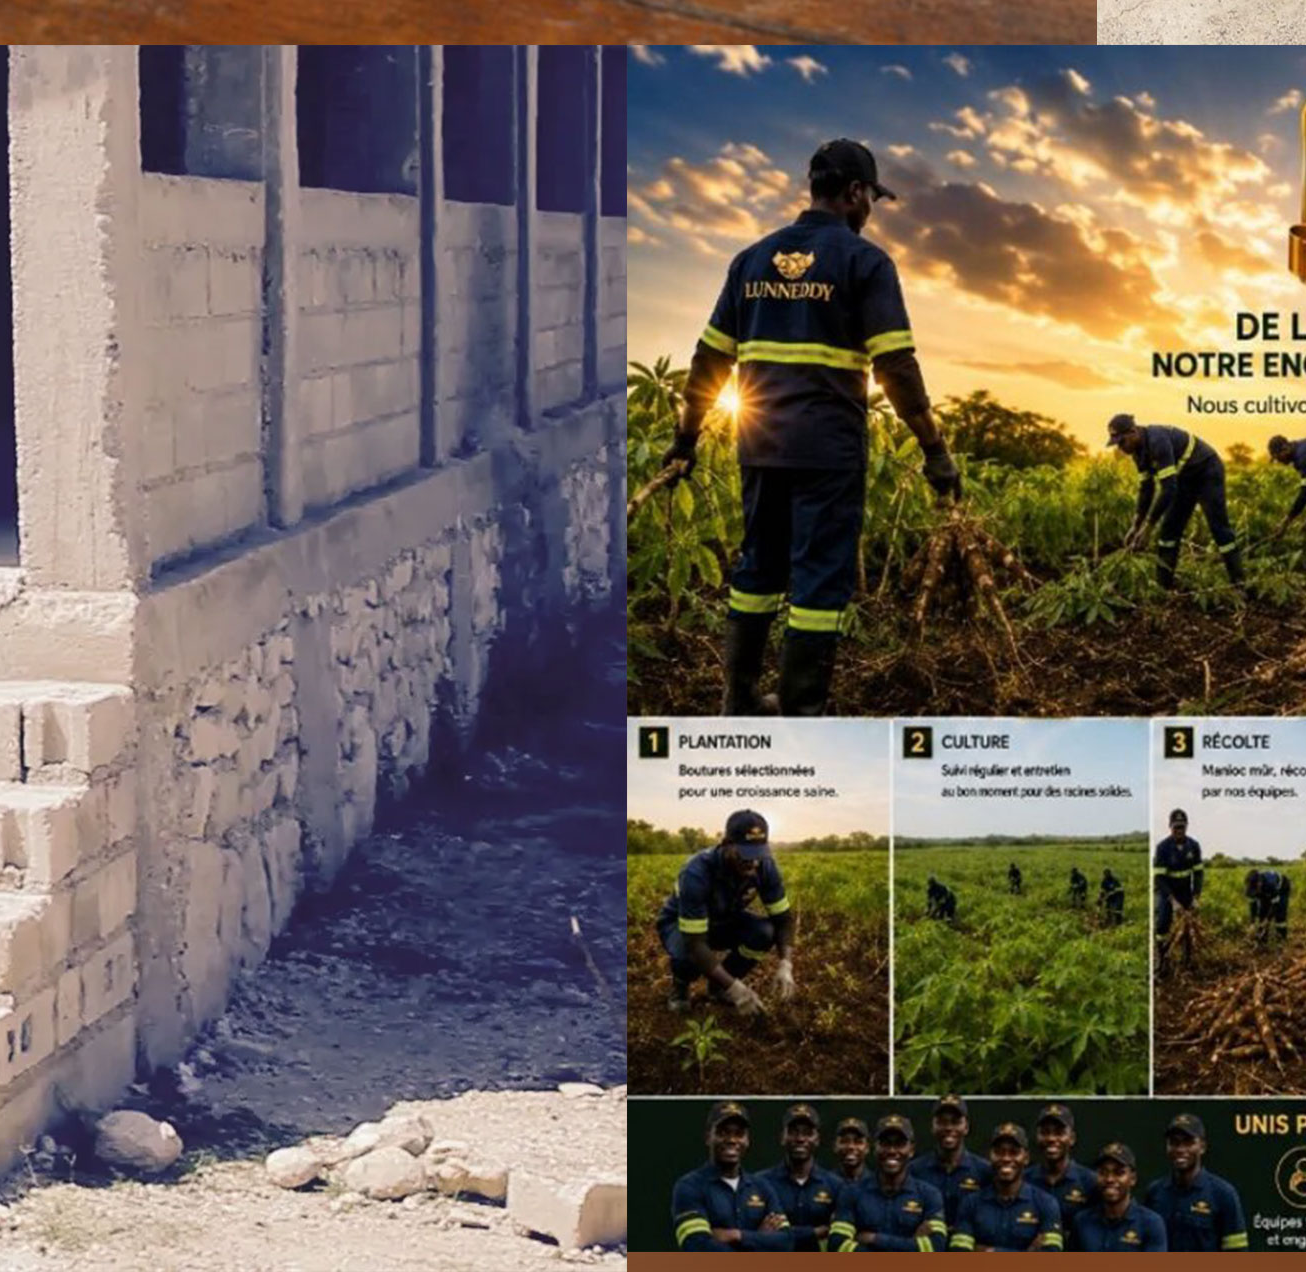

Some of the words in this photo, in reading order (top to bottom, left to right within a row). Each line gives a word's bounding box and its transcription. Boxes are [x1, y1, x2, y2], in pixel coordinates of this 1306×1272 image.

[745, 282, 836, 302] LUNNEDDY
[1236, 312, 1280, 341] DE
[1152, 351, 1253, 378] NOTRE
[1187, 395, 1239, 415] Nous
[647, 732, 660, 753] 1
[678, 734, 772, 750] PLANTATION
[910, 732, 925, 753] 2
[941, 734, 1010, 750] CULTURE
[1171, 731, 1188, 753] 3
[1202, 731, 1270, 750] RÉCOLTE
[678, 763, 732, 777] Boutures
[941, 763, 967, 777] Suivi
[968, 764, 1009, 780] régulier
[1010, 765, 1022, 777] et
[1023, 764, 1072, 777] entretien
[1202, 764, 1246, 777] Manioc
[678, 787, 707, 800] pour
[709, 787, 734, 798] une
[735, 787, 801, 798] croissance
[803, 786, 840, 799] saine.
[941, 788, 955, 798] au
[956, 785, 977, 798] bon
[978, 786, 1018, 798] moment
[1020, 787, 1043, 799] pour
[1044, 785, 1062, 798] des
[1063, 787, 1097, 798] racines
[1201, 787, 1222, 800] par
[1224, 787, 1246, 798] nos
[1247, 786, 1298, 800] équipes.
[1235, 1113, 1289, 1135] UNIS
[1253, 1213, 1303, 1231] Équipes
[1266, 1233, 1280, 1246] et
